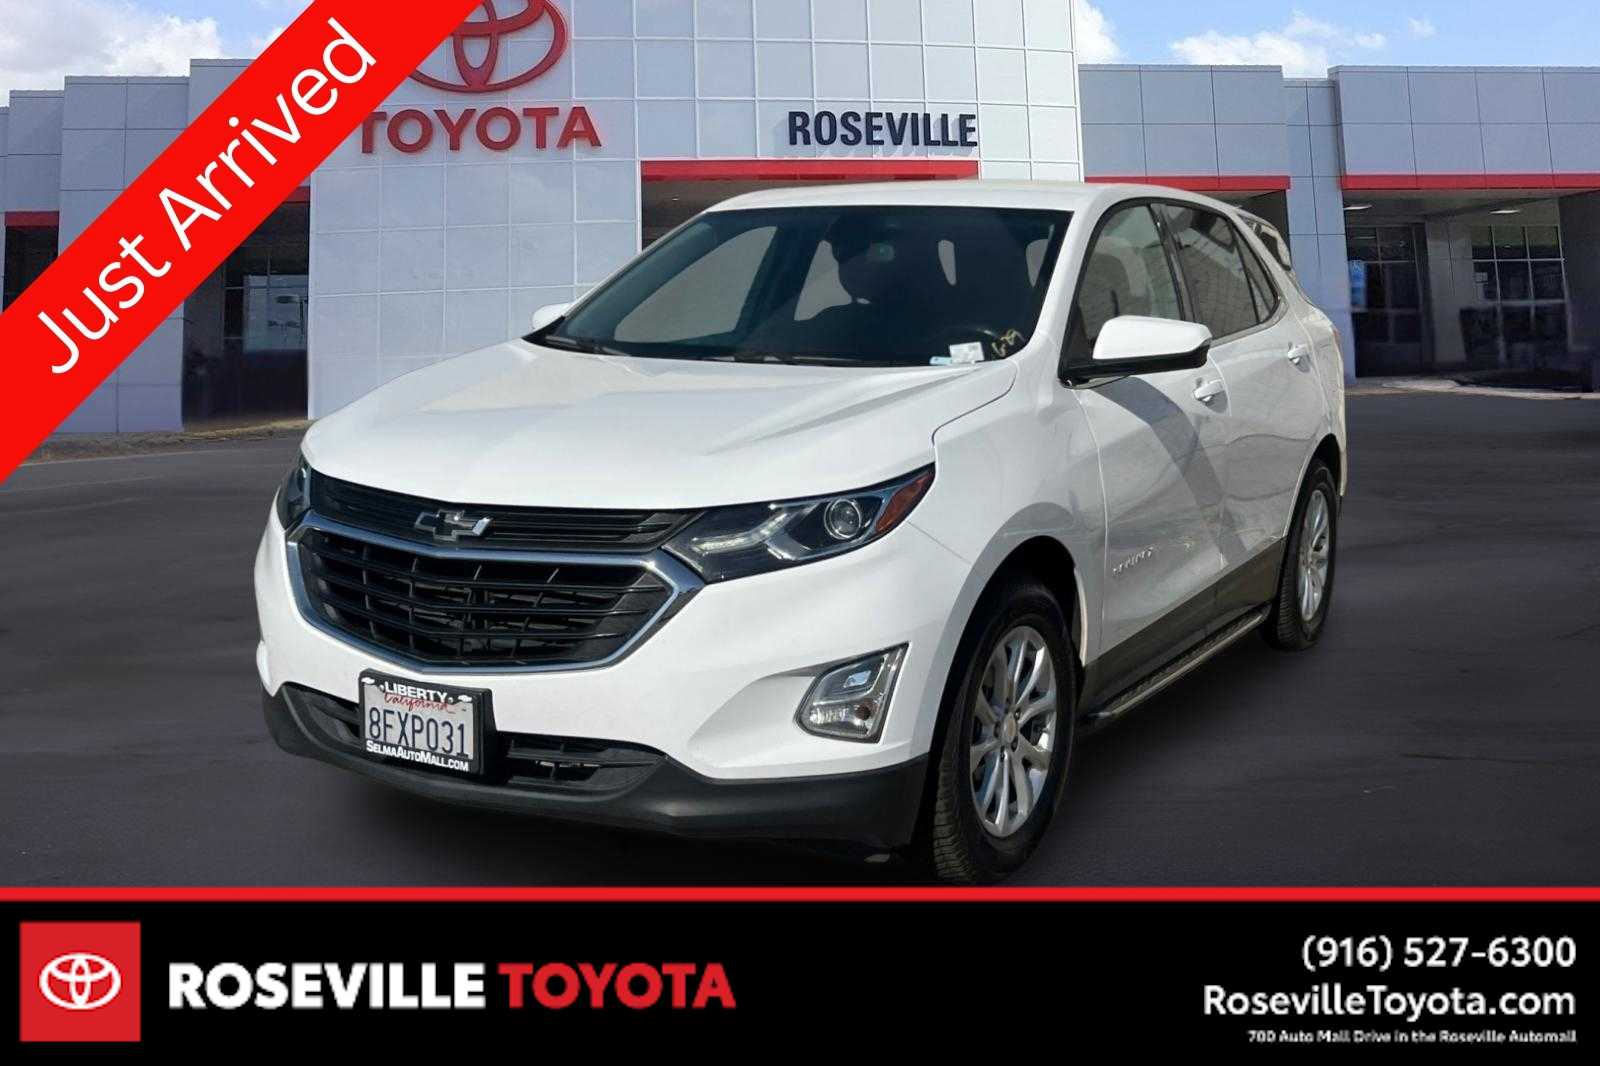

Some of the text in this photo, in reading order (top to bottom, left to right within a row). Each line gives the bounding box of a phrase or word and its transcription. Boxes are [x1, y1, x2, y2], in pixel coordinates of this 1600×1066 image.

[361, 106, 602, 154] TOYOTA
[788, 111, 978, 147] ROSEVILLE
[385, 681, 448, 703] LIBERTY
